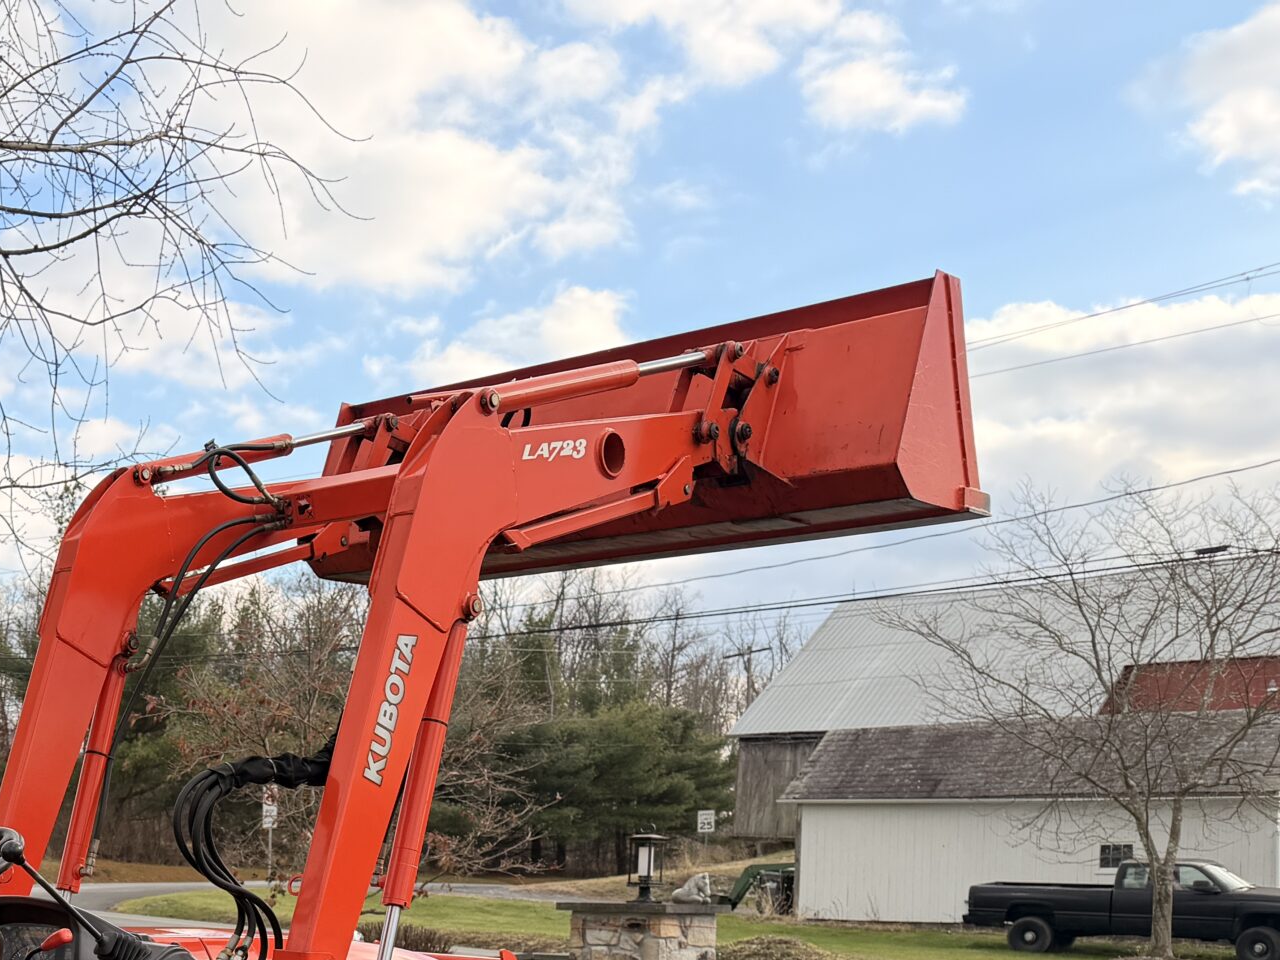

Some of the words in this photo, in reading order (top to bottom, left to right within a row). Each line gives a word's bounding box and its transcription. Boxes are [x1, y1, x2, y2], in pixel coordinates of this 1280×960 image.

[522, 438, 587, 462] LA723
[363, 634, 418, 786] KUBOTA
[700, 821, 713, 830] 25
